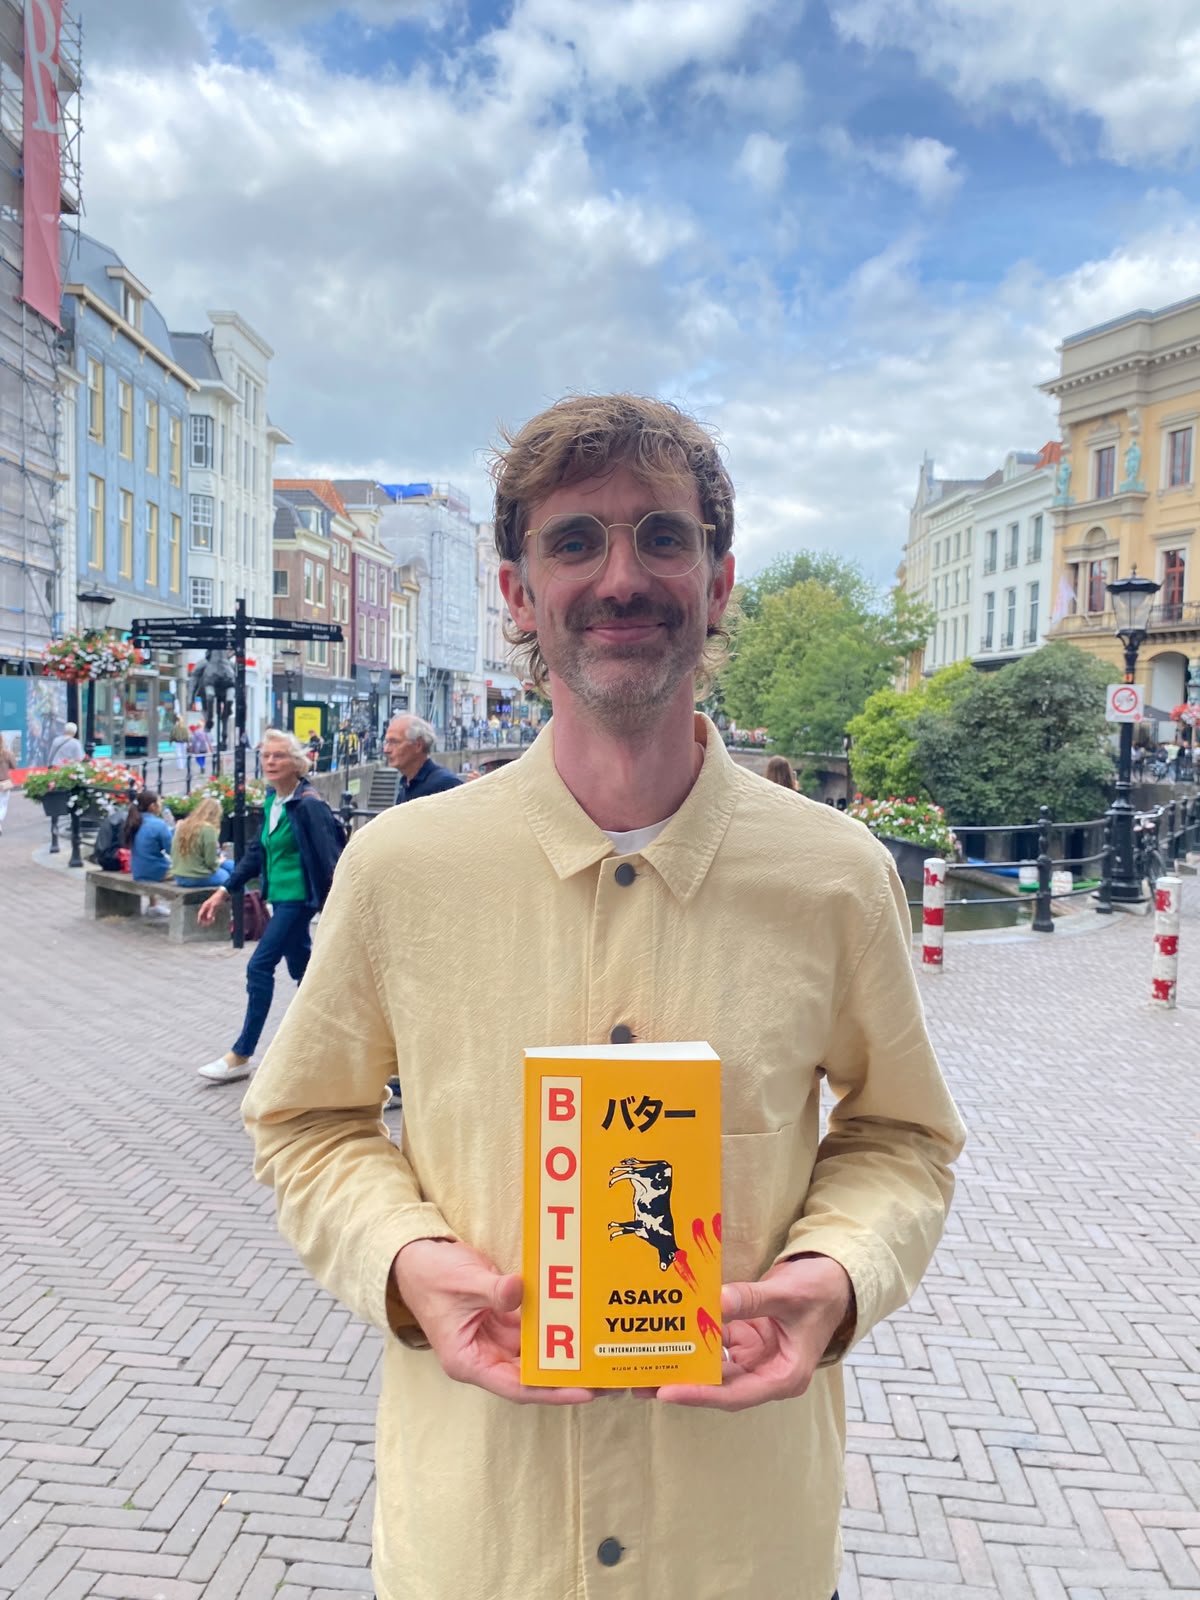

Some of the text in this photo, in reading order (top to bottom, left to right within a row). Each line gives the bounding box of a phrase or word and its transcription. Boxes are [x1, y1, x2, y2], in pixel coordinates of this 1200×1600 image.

[601, 1095, 696, 1133] バター
[545, 1087, 577, 1359] BOTER
[608, 1289, 683, 1305] ASAKO
[605, 1316, 686, 1333] YUZUKI
[658, 1344, 692, 1352] BESTSELLER
